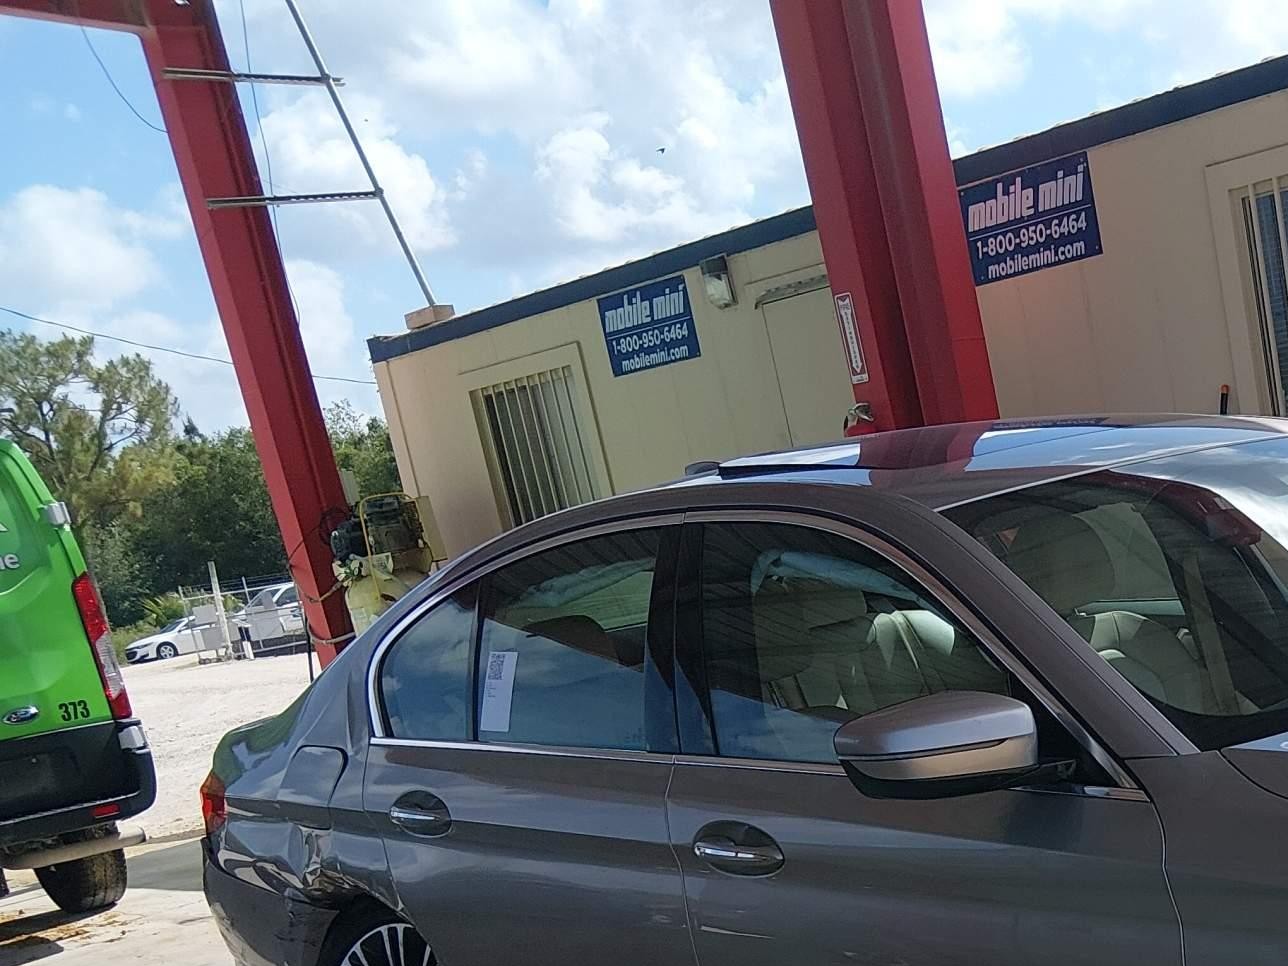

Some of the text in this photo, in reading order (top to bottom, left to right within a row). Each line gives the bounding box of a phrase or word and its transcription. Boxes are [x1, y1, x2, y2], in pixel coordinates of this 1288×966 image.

[968, 164, 1084, 232] mobile mini
[976, 211, 1087, 259] 1-800-950-6464
[988, 240, 1086, 279] mobilemini.com
[605, 284, 684, 333] mobile mini
[612, 321, 688, 355] 1-800-950-6464
[621, 345, 688, 372] mobilemini.com
[58, 700, 90, 721] 373
